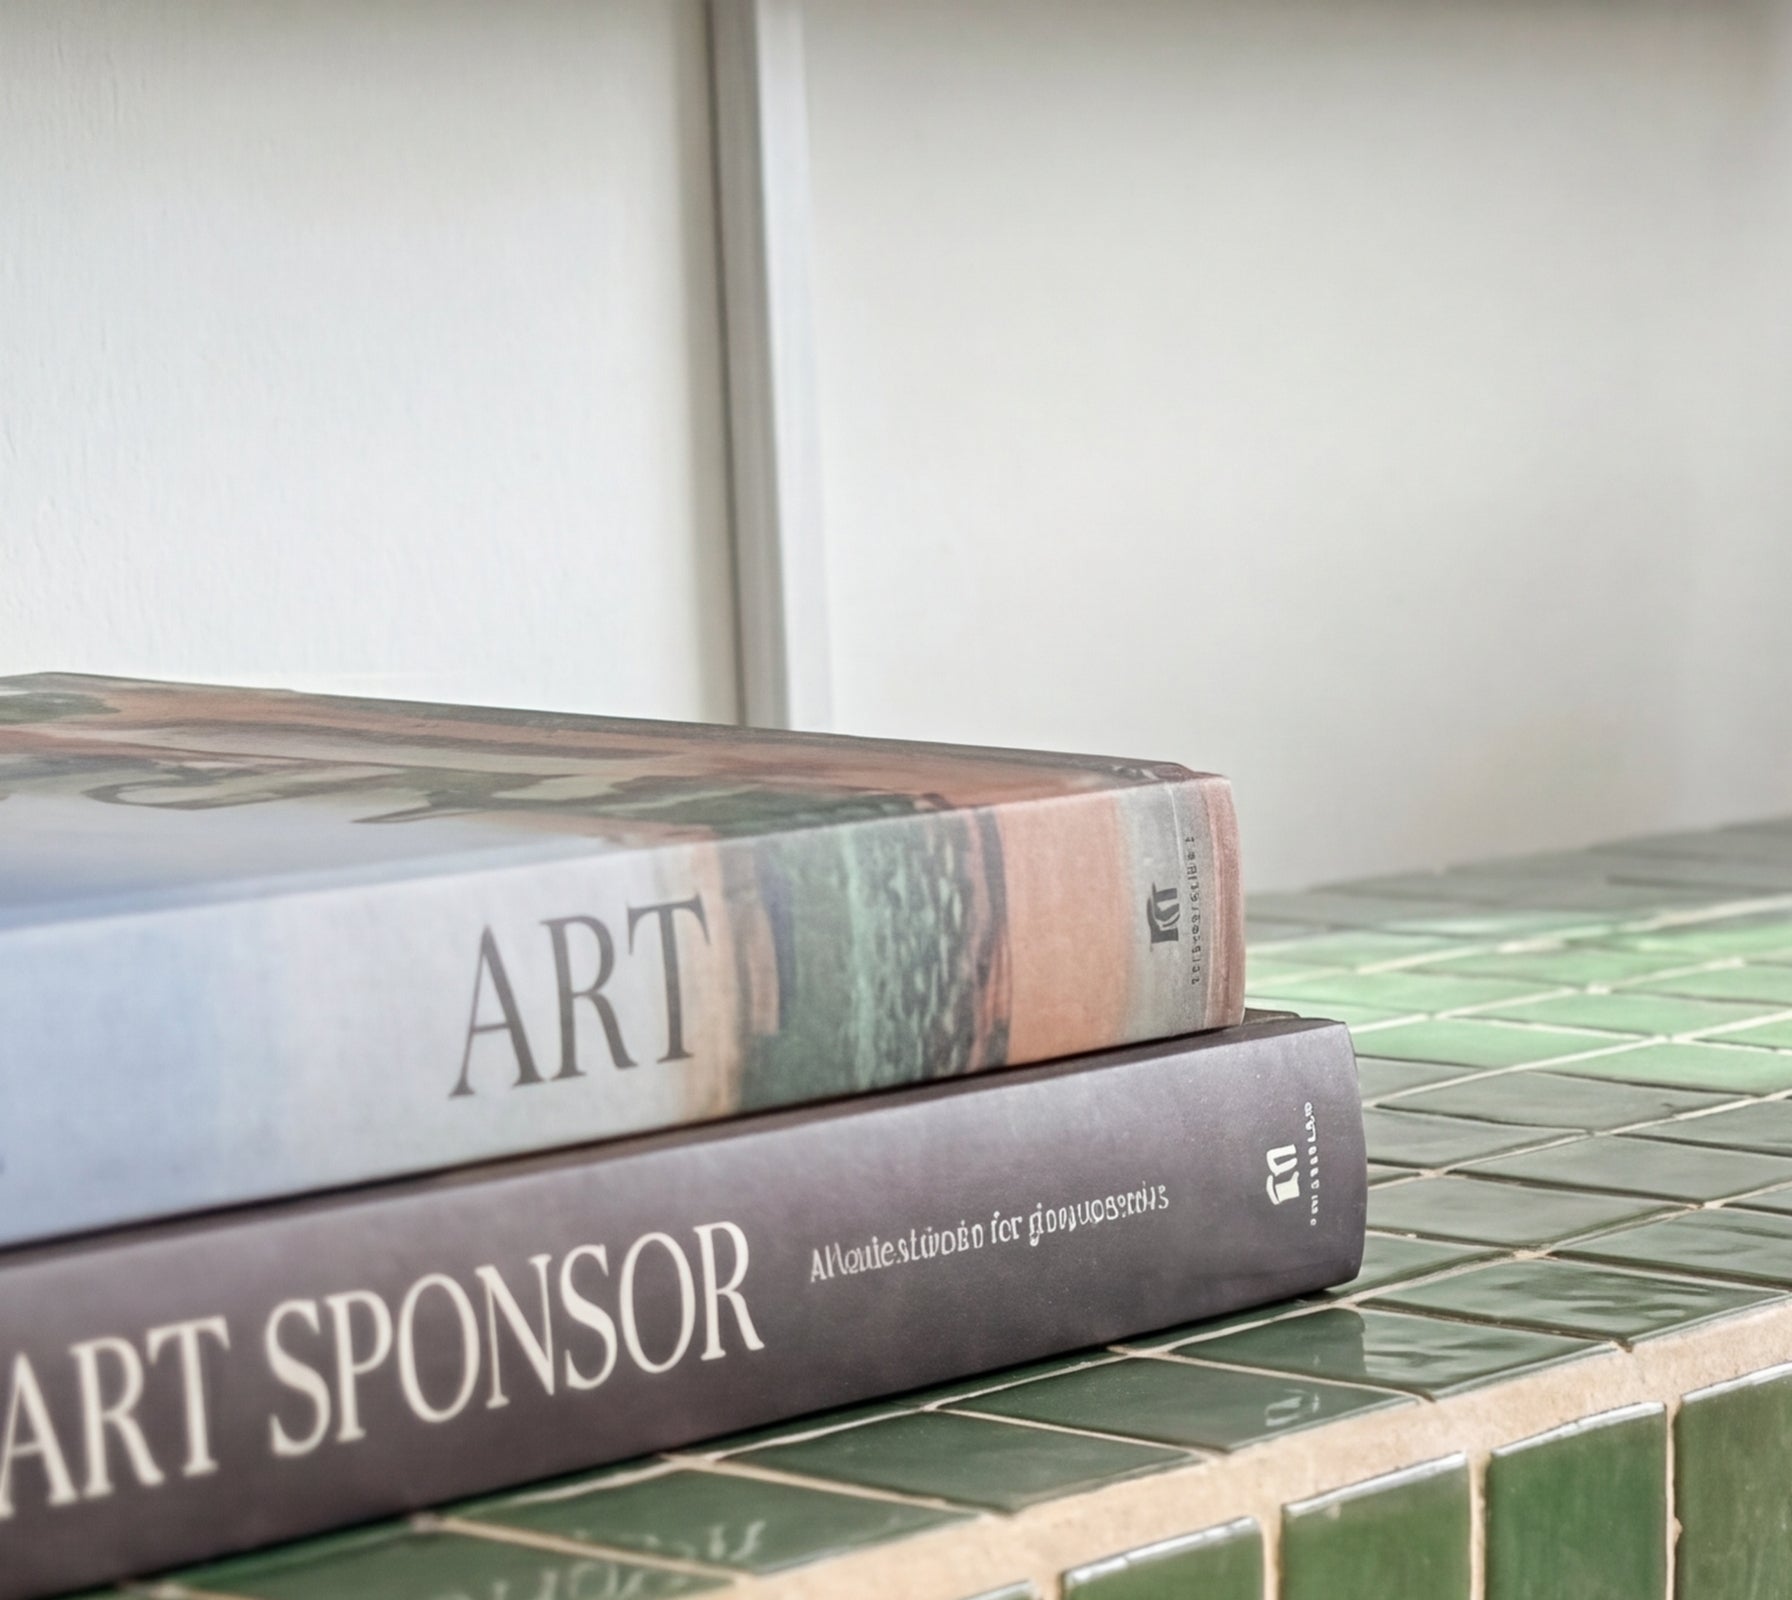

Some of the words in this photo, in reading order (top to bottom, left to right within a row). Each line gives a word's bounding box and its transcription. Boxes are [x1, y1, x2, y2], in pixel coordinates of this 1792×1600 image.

[448, 893, 711, 1098] ART
[0, 1315, 231, 1519] ART
[264, 1221, 765, 1457] SPONSOR
